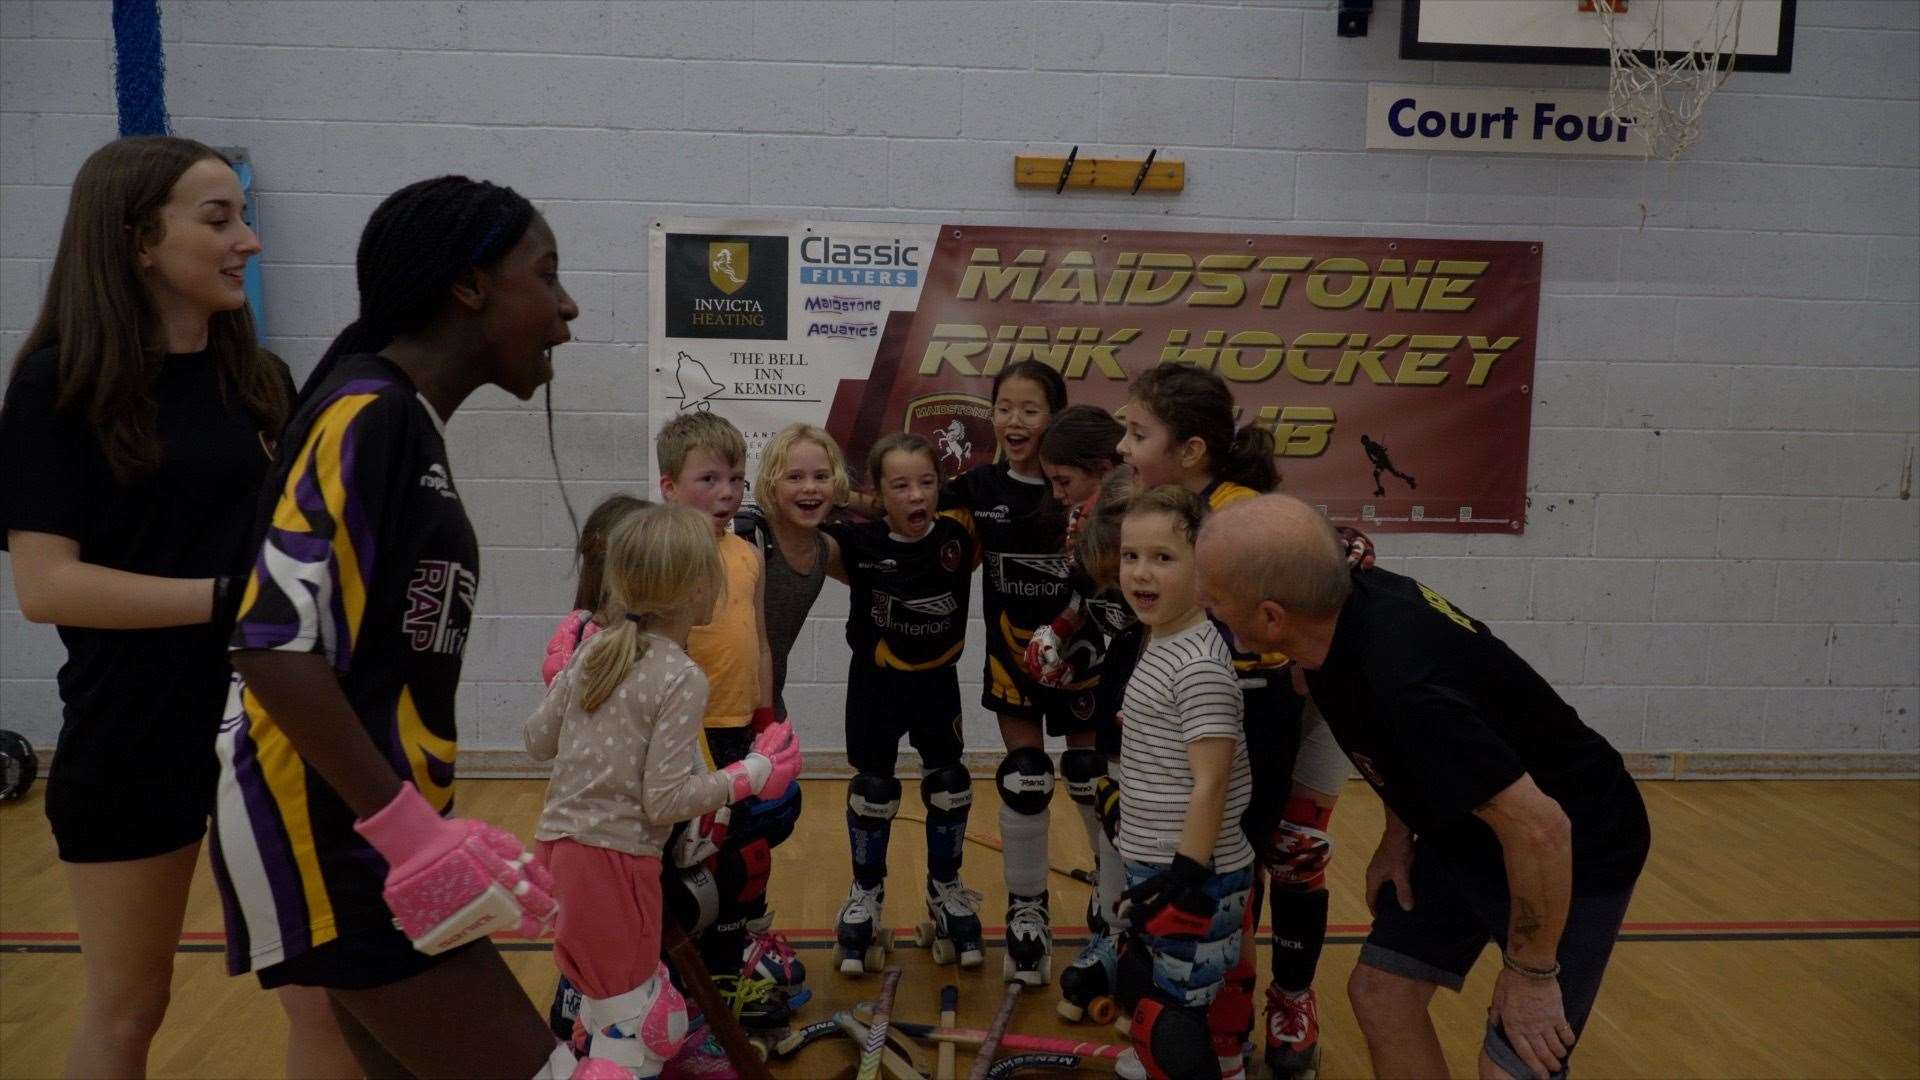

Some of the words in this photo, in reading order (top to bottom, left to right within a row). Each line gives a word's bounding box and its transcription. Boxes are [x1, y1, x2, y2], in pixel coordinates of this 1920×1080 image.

[1387, 98, 1518, 138] Court
[1533, 102, 1637, 142] Four
[800, 236, 918, 266] Classic
[812, 269, 907, 285] FILTERS
[956, 247, 1490, 312] MAIDSTONE
[694, 298, 763, 312] INVICTA
[692, 313, 764, 327] HEATING
[730, 352, 763, 365] THE
[769, 353, 808, 366] BELL
[918, 323, 1143, 381] RINK
[1159, 330, 1522, 387] HOCKEY
[754, 368, 783, 381] INN
[734, 382, 806, 396] KEMSING
[402, 559, 450, 651] RAP
